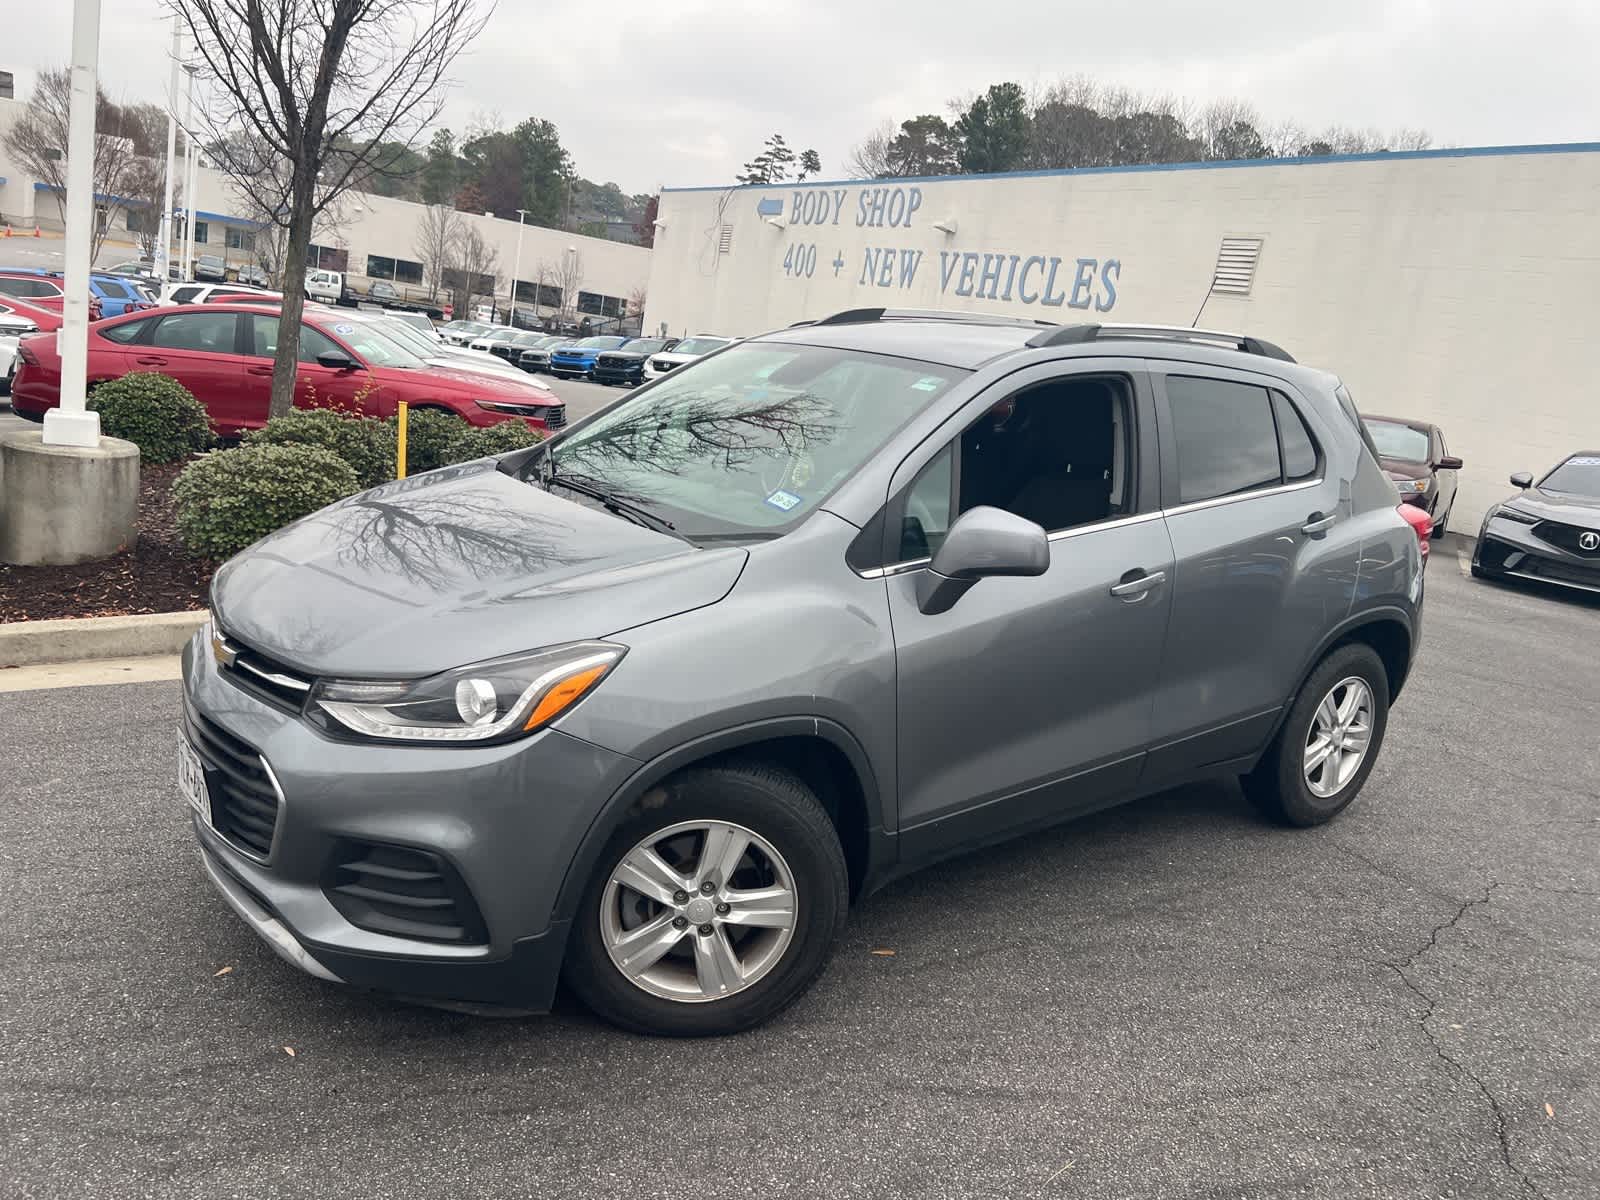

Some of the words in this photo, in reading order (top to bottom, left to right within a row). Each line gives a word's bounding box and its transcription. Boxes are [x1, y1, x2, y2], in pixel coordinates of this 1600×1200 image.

[790, 190, 847, 225] BODY
[856, 187, 922, 228] SHOP
[783, 243, 817, 279] 400
[833, 250, 844, 277] +
[859, 248, 923, 289] NEW
[939, 251, 1121, 313] VEHICLES
